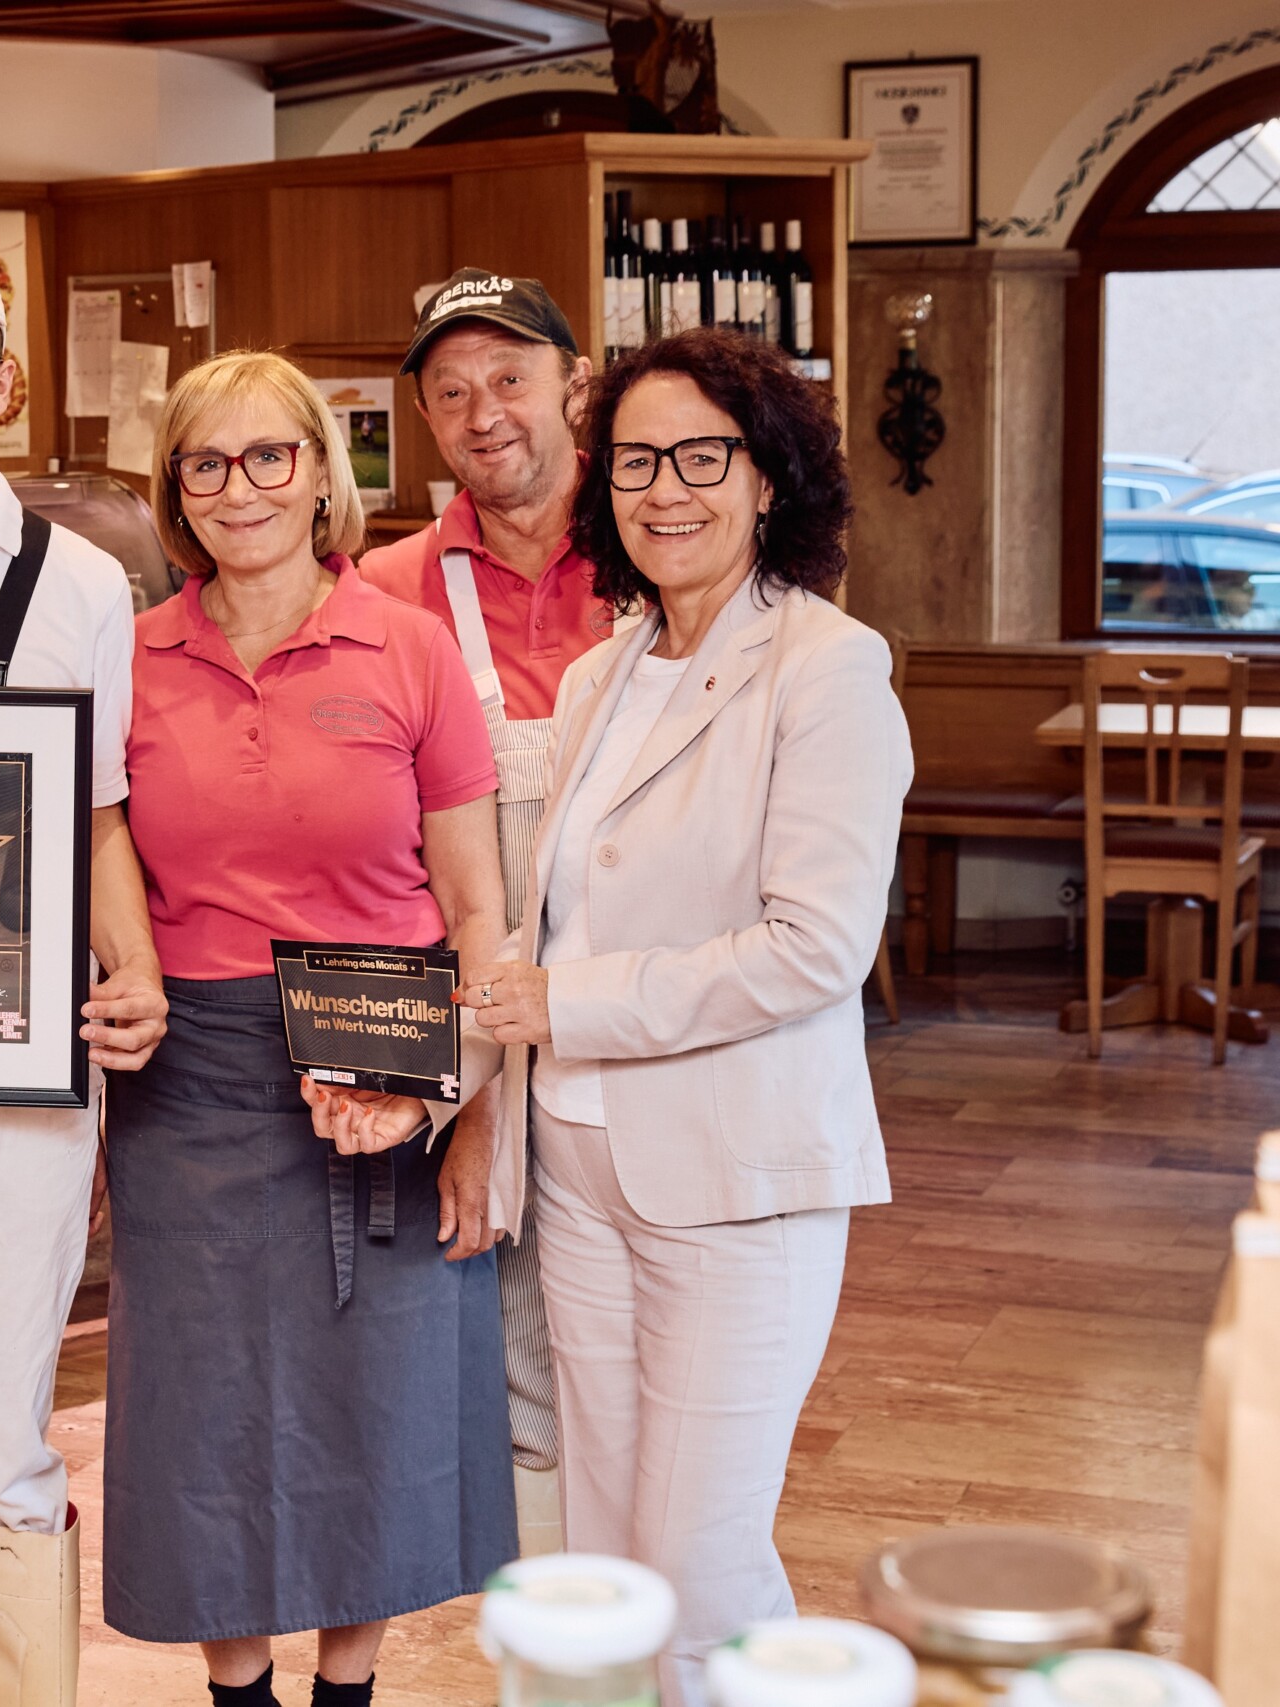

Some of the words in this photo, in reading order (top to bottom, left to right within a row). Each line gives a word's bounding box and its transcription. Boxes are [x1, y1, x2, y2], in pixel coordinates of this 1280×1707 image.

[323, 957, 359, 970] Lehrling
[359, 959, 376, 969] des
[375, 960, 408, 972] Monats
[288, 988, 450, 1025] Wunscherfüller
[314, 1016, 331, 1030] im
[333, 1017, 365, 1033] Wert
[365, 1023, 390, 1036] von
